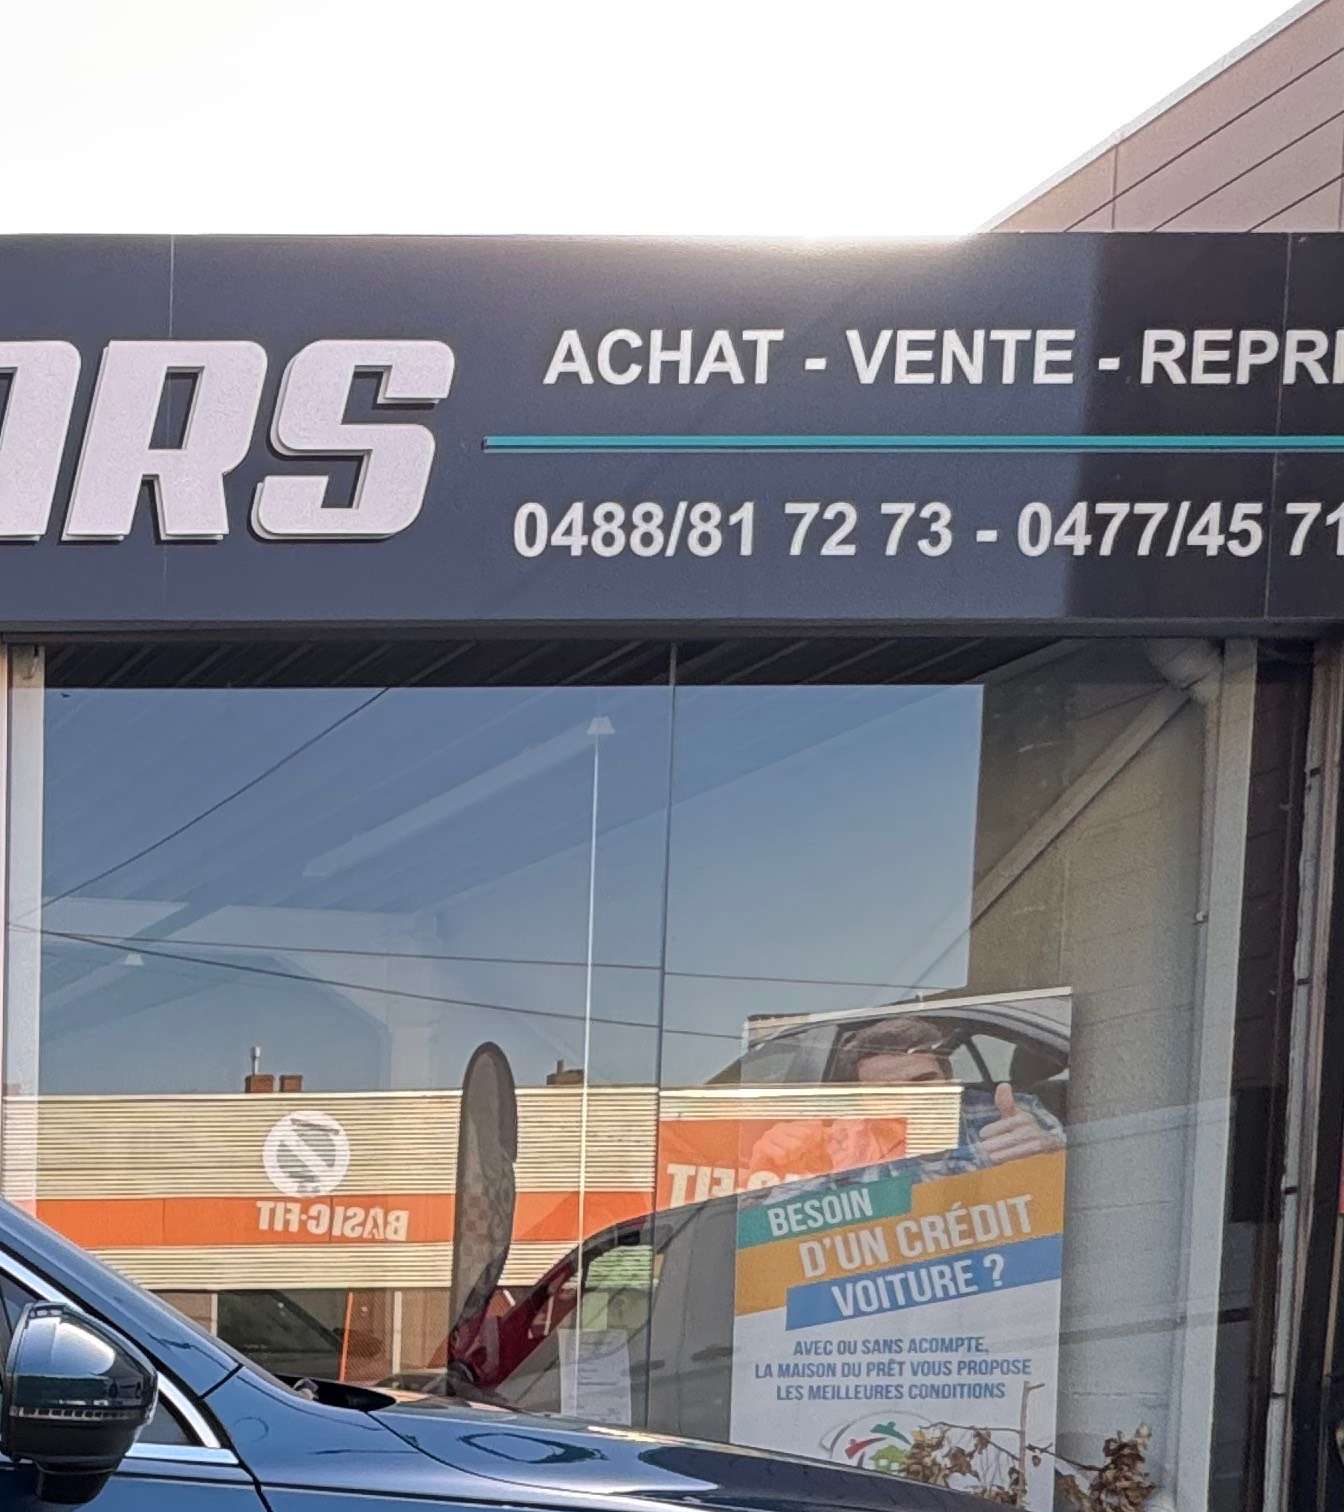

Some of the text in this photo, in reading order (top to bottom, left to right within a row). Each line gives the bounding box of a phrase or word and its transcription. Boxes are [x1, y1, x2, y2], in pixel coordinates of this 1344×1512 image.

[544, 329, 784, 384] ACHAT
[846, 329, 1075, 384] VENTE
[514, 501, 754, 557] 0488/81
[785, 501, 857, 556] 72
[881, 501, 952, 557] 73
[1018, 501, 1263, 557] 0477/45
[1287, 501, 1344, 556] 71
[767, 1188, 873, 1237] BESOIN
[799, 1194, 1033, 1278] D'UN CRÉDIT
[831, 1260, 977, 1316] VOITURE
[755, 1358, 1032, 1379] LA MAISON DU PRÊT VOUS PROPOSE
[793, 1336, 989, 1356] AVEC OU SANS ACOMPTE,
[777, 1382, 1005, 1401] LES MEILLEURES CONDITIONS
